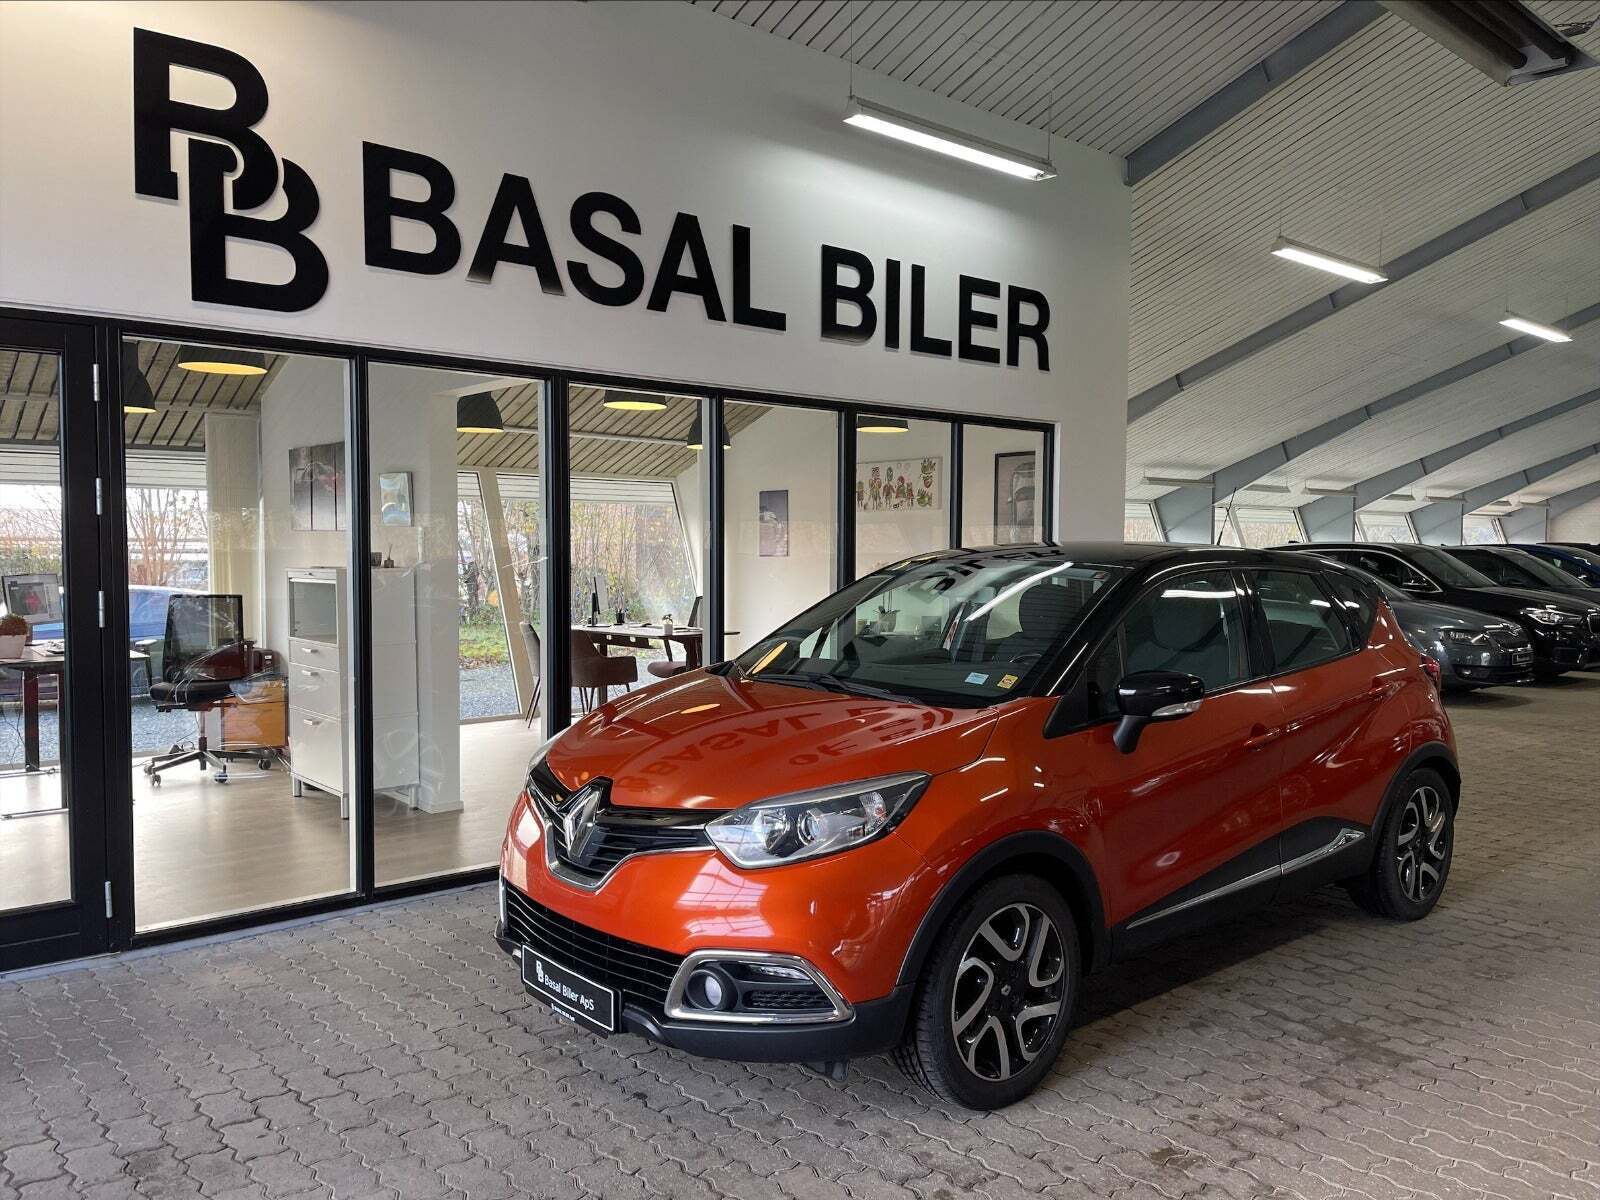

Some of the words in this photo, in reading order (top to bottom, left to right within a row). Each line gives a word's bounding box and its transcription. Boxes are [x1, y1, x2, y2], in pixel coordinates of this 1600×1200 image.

[362, 141, 787, 331] BASAL
[821, 243, 1051, 371] BILER
[544, 974, 561, 993] Basal
[562, 984, 579, 1002] Biler
[579, 994, 595, 1010] ApS
